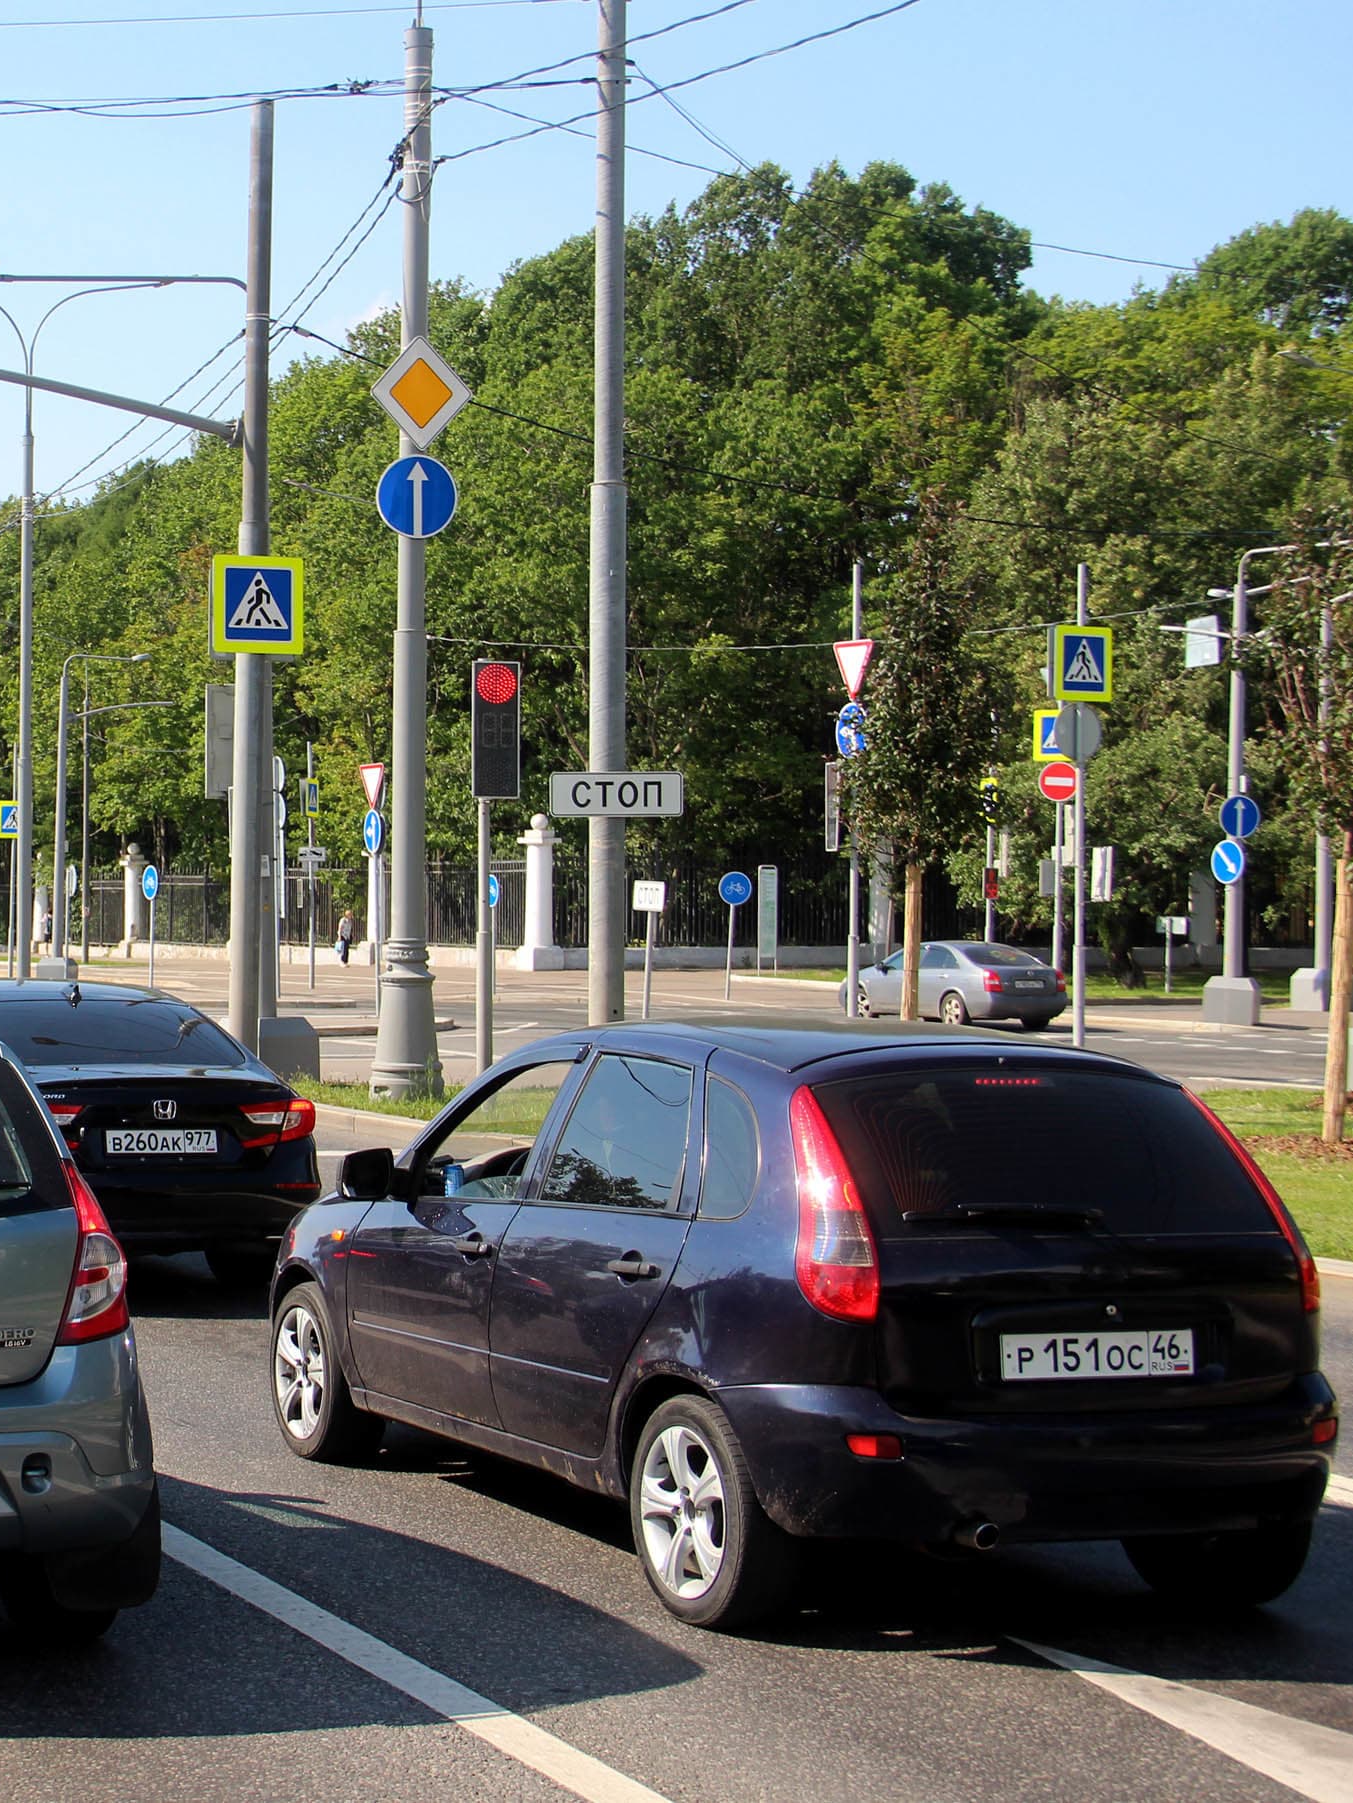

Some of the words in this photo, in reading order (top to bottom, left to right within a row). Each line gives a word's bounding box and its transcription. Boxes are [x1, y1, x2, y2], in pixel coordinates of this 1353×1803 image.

[571, 780, 662, 808] СТОП
[112, 1132, 182, 1152] В260АК
[185, 1131, 212, 1146] 977
[1017, 1338, 1144, 1374] Р151ОС
[1152, 1334, 1181, 1360] 46
[1151, 1361, 1173, 1371] RUS
